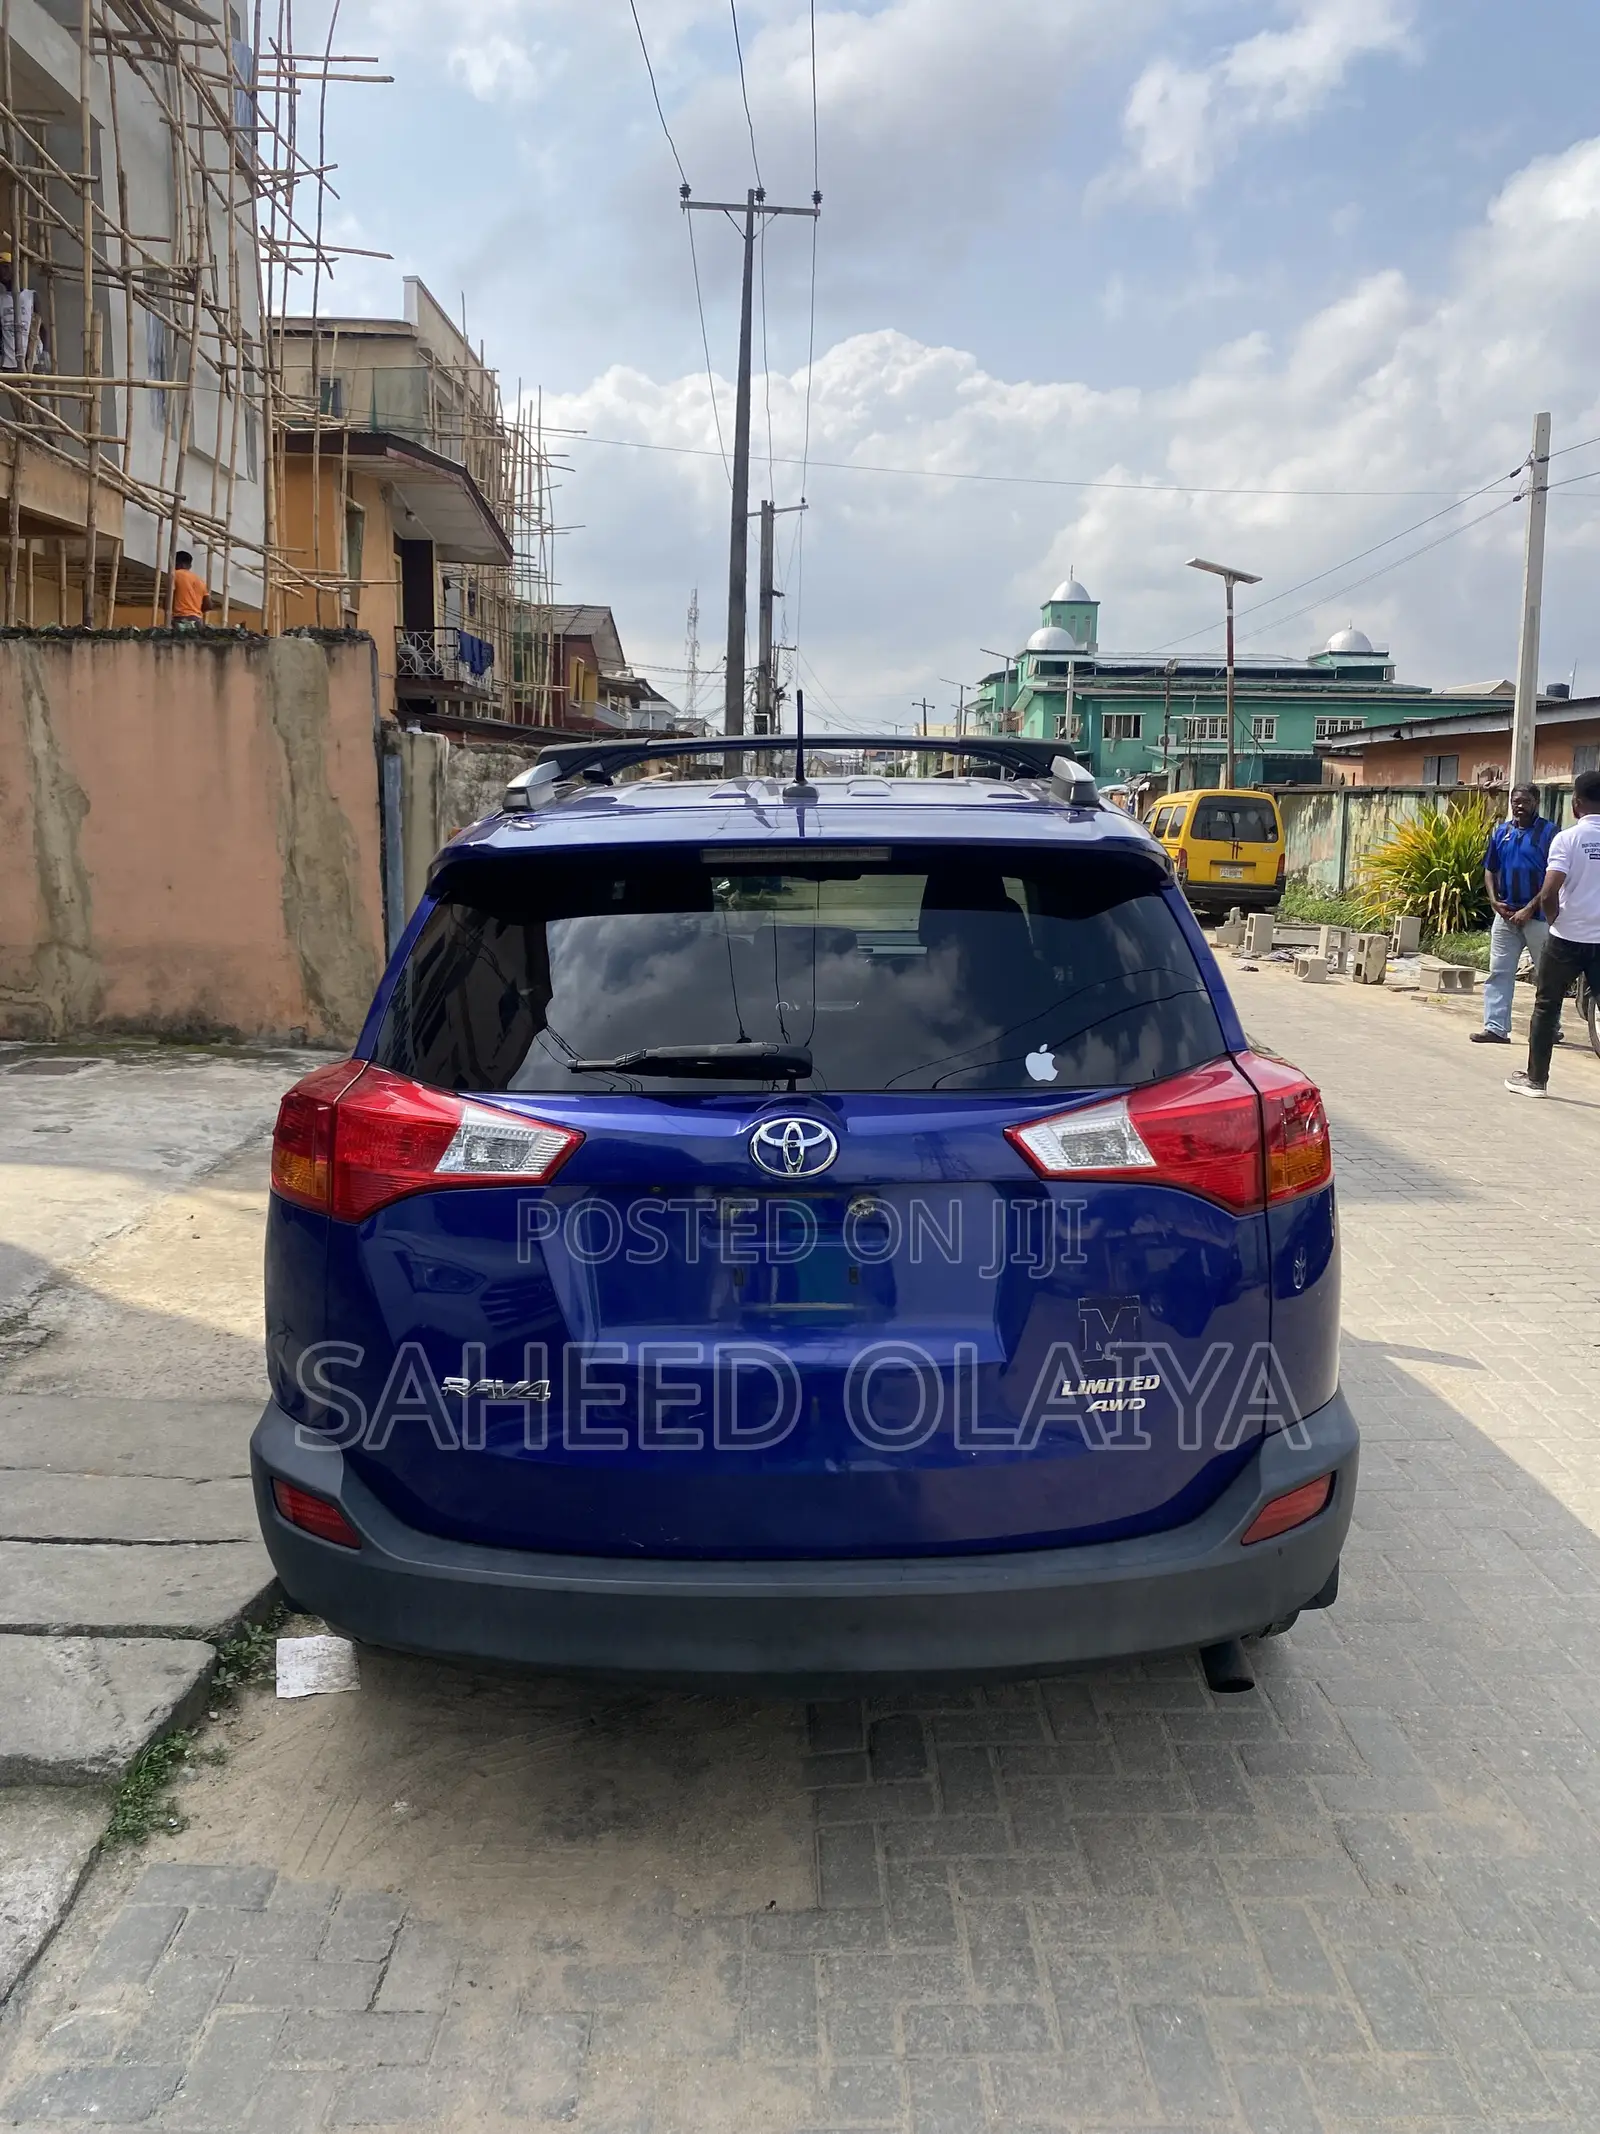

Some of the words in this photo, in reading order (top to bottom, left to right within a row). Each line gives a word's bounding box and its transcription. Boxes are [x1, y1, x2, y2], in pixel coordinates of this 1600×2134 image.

[440, 1376, 551, 1401] RAV4
[1061, 1374, 1161, 1396] LIMITED
[1085, 1397, 1147, 1413] AWD
